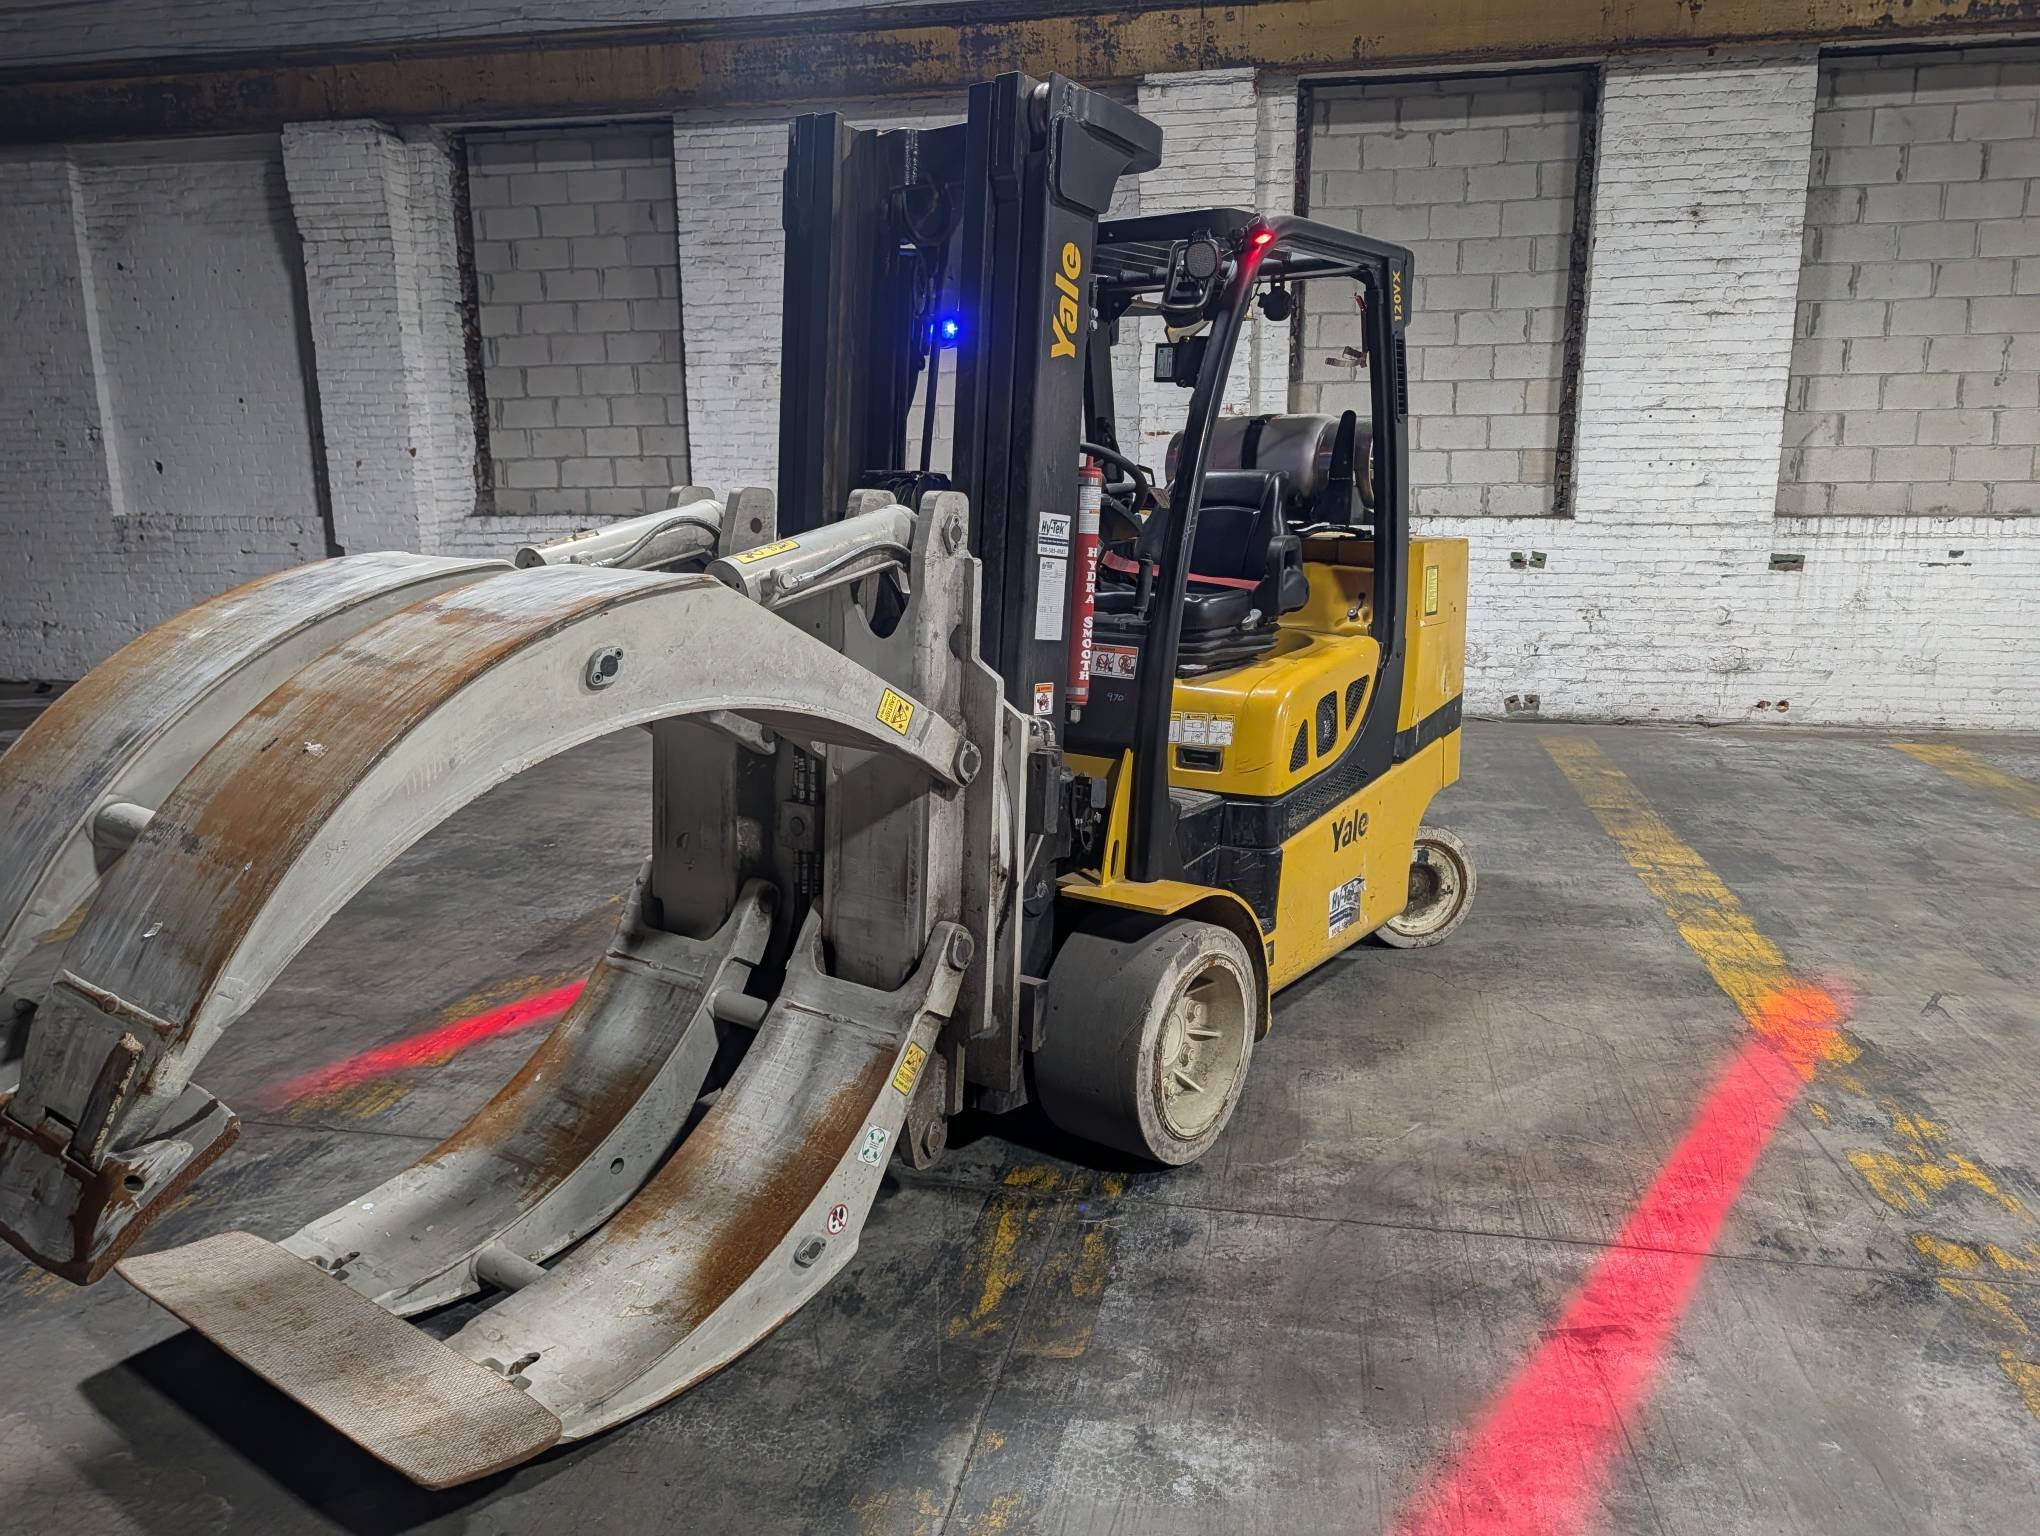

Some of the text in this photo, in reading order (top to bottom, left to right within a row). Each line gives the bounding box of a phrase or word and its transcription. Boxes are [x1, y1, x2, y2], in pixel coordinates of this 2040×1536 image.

[1051, 242, 1081, 358] Yale
[1392, 269, 1402, 321] 120VX
[1041, 519, 1064, 535] Hy-Tek
[1079, 547, 1097, 681] HYDRA SMOOTH
[1332, 809, 1369, 853] Yale
